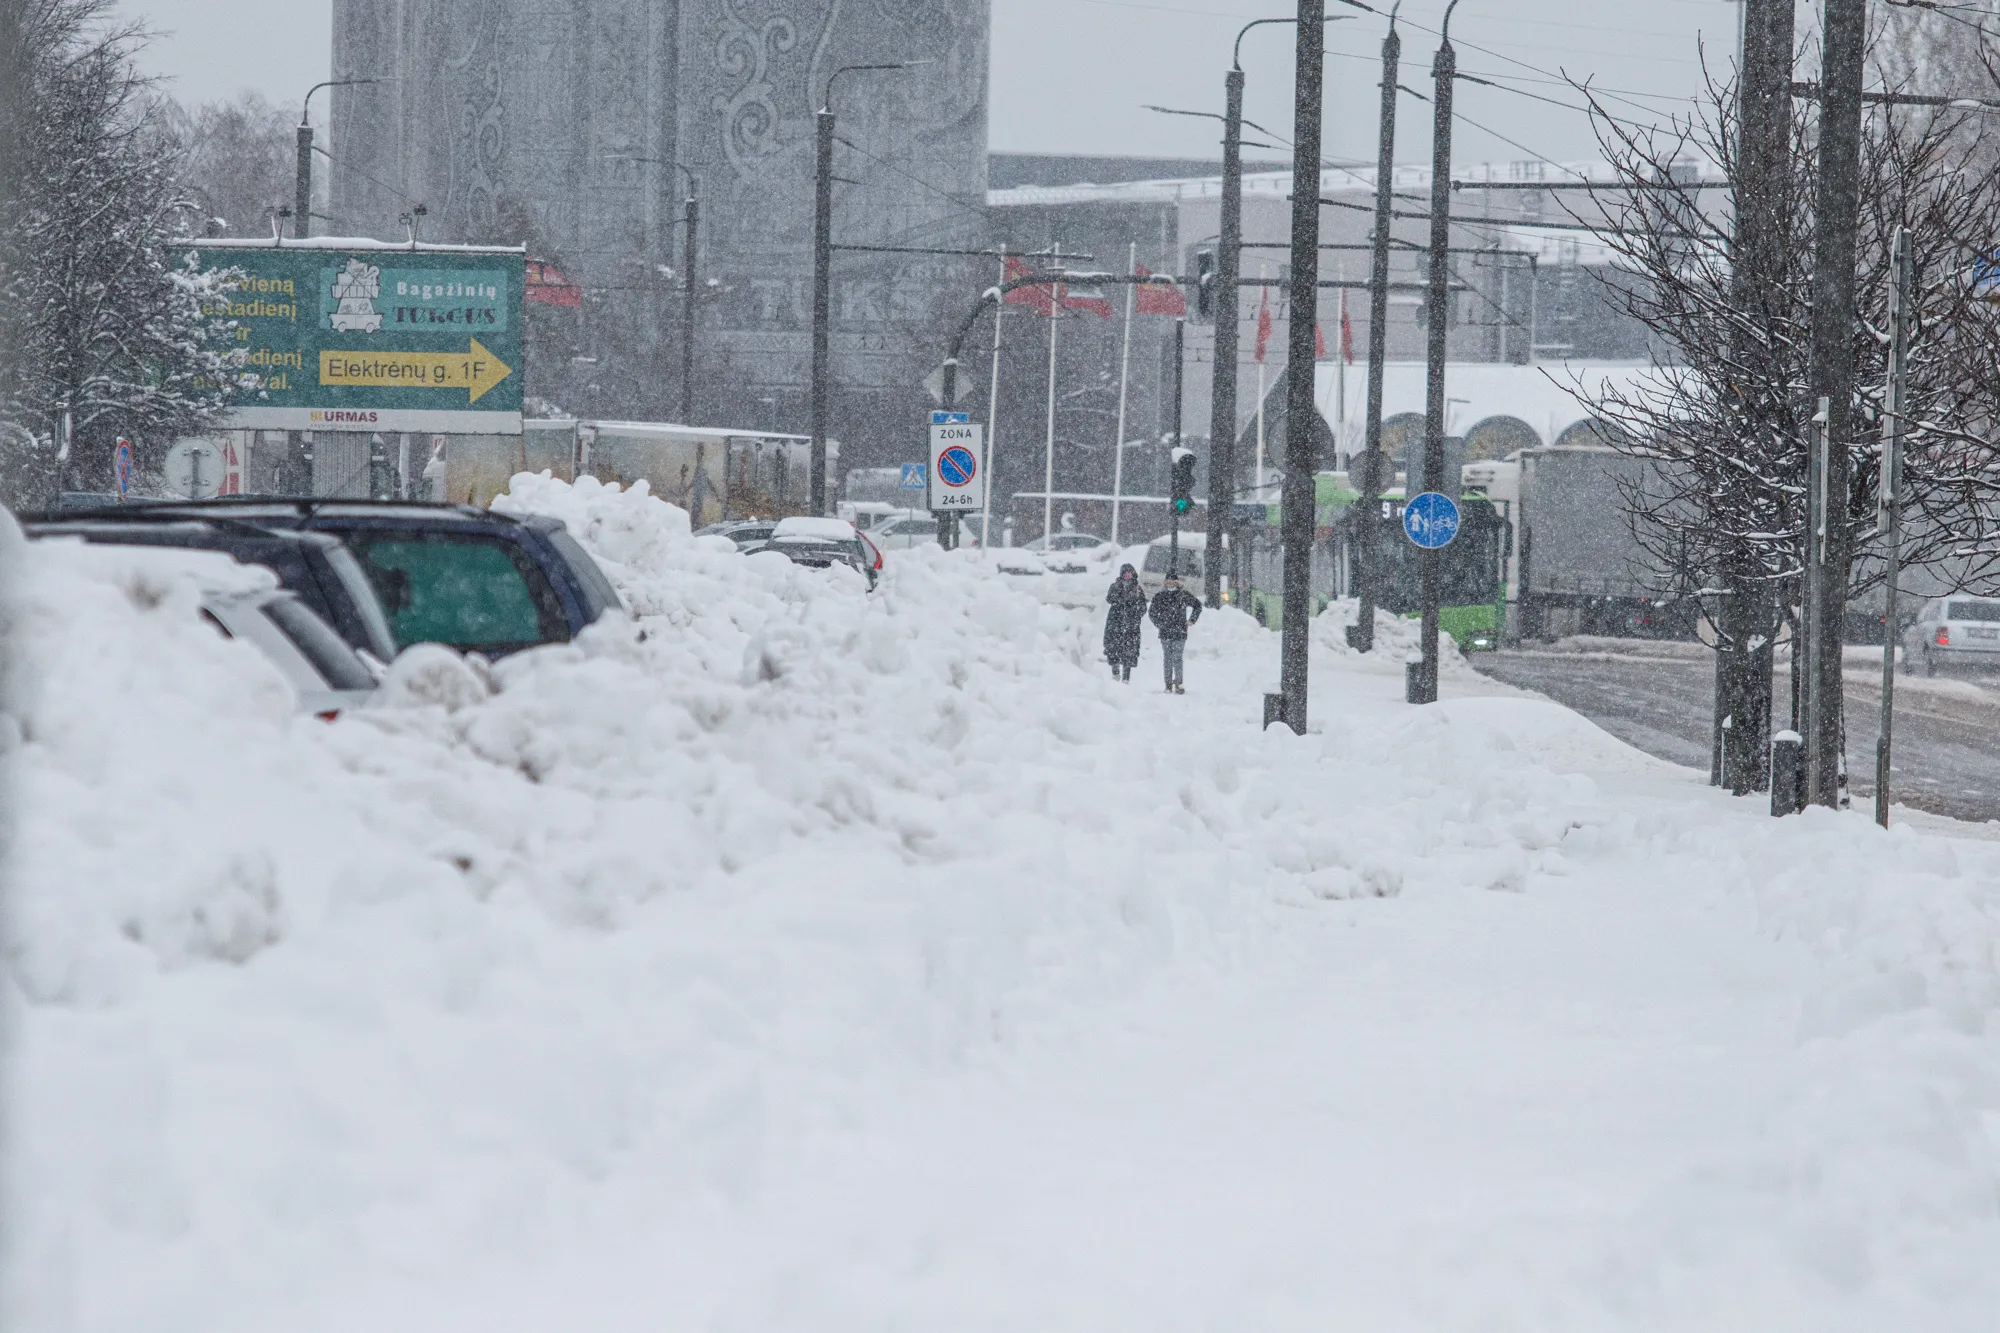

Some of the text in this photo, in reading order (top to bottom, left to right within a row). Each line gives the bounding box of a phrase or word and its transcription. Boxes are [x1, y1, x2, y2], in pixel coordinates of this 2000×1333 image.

[396, 281, 497, 300] Bagažinių
[392, 306, 497, 325] TURGUS
[328, 358, 487, 384] Elektrėnų g. 1F
[324, 411, 378, 423] URMAS
[940, 429, 973, 439] ZONA
[942, 494, 973, 505] 24-6h
